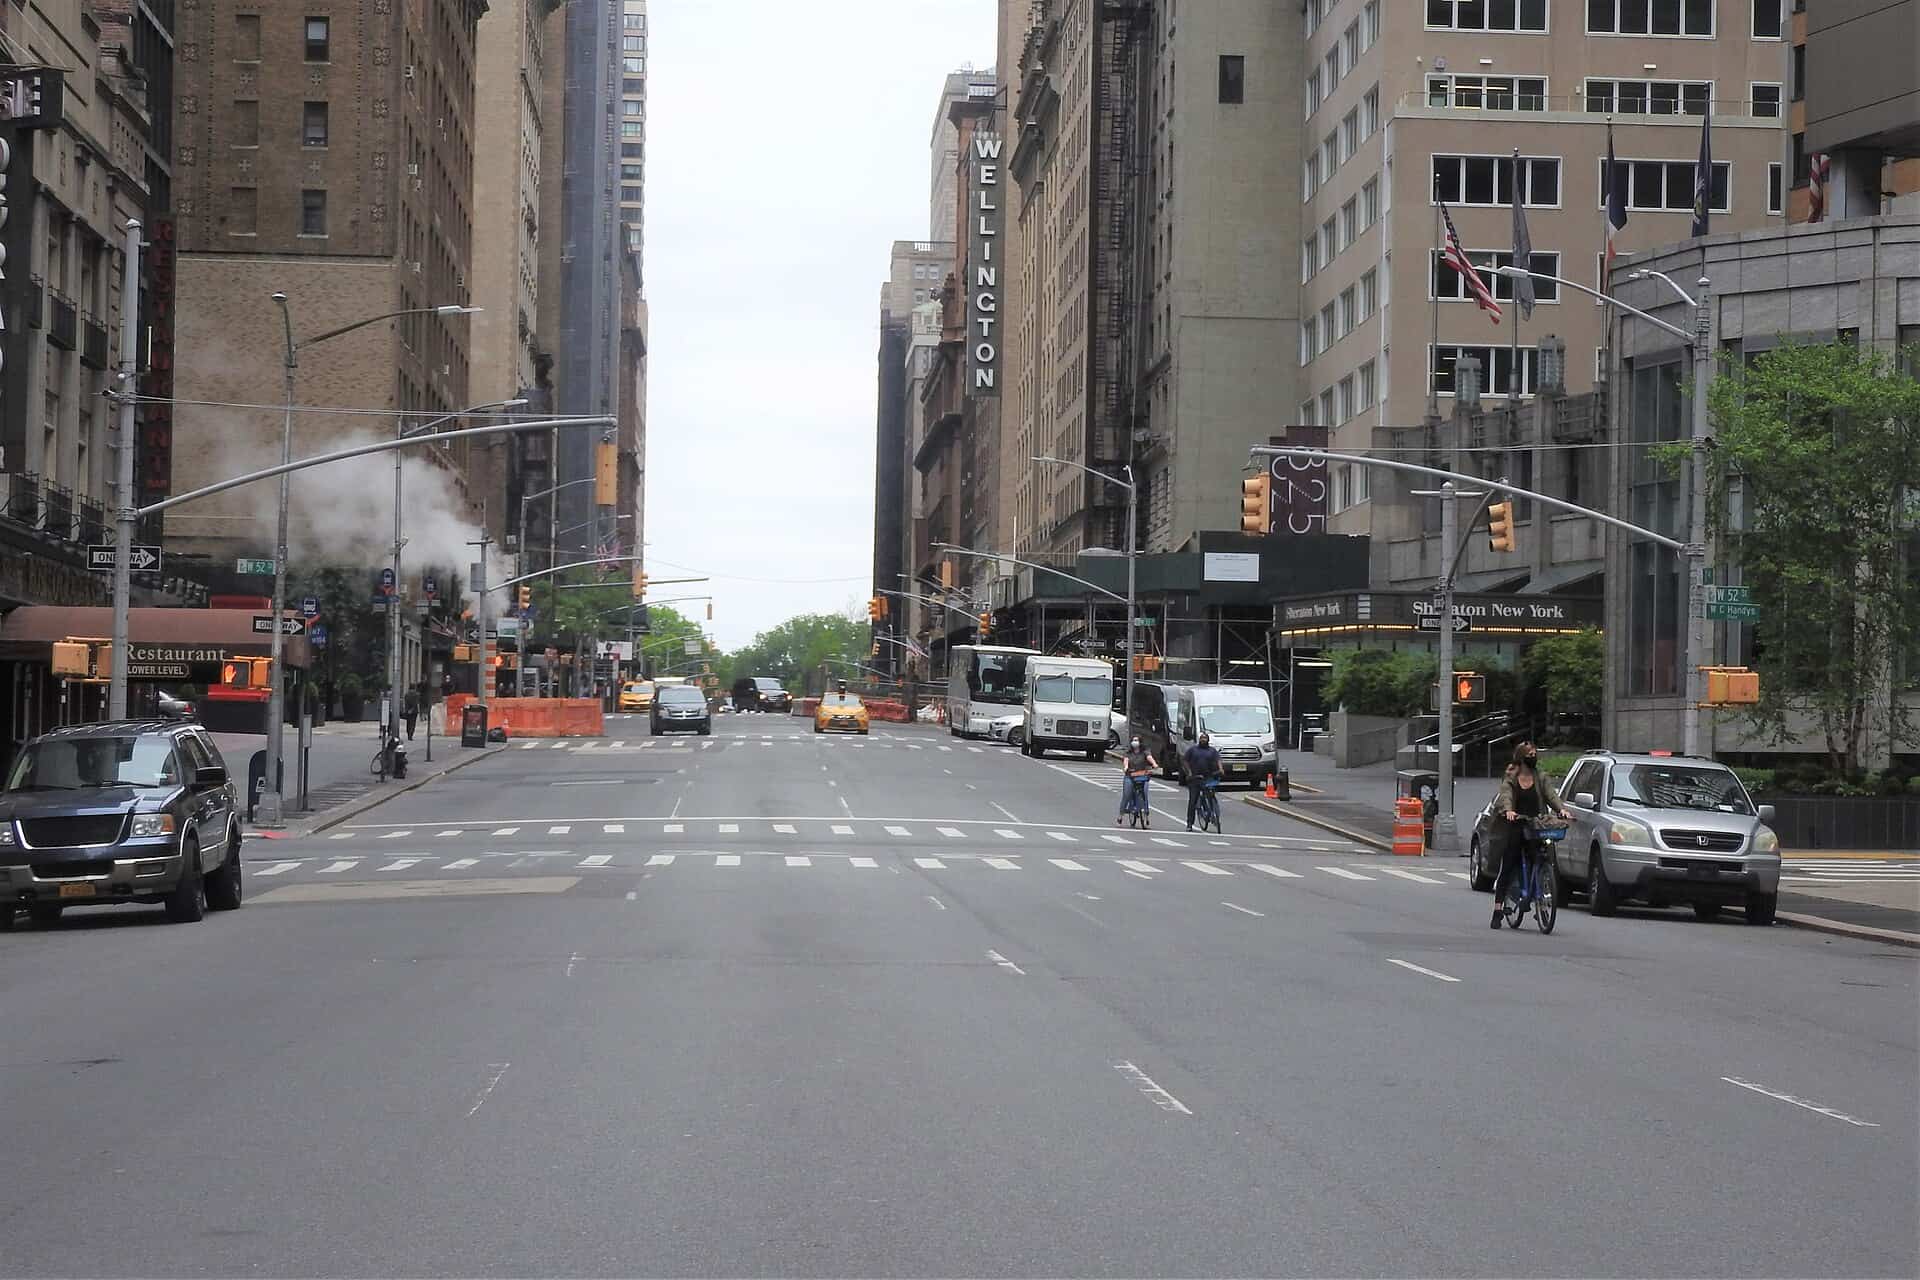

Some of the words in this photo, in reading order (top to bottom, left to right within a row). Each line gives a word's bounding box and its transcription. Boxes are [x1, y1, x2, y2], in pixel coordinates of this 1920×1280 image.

[975, 140, 1003, 388] WELLINGTON
[1717, 588, 1724, 601] W
[1728, 588, 1738, 601] 52
[1412, 601, 1486, 616] Shaton
[1492, 603, 1525, 617] New
[1529, 604, 1564, 618] York
[128, 665, 156, 675] LOWER
[158, 665, 184, 675] LEVEL
